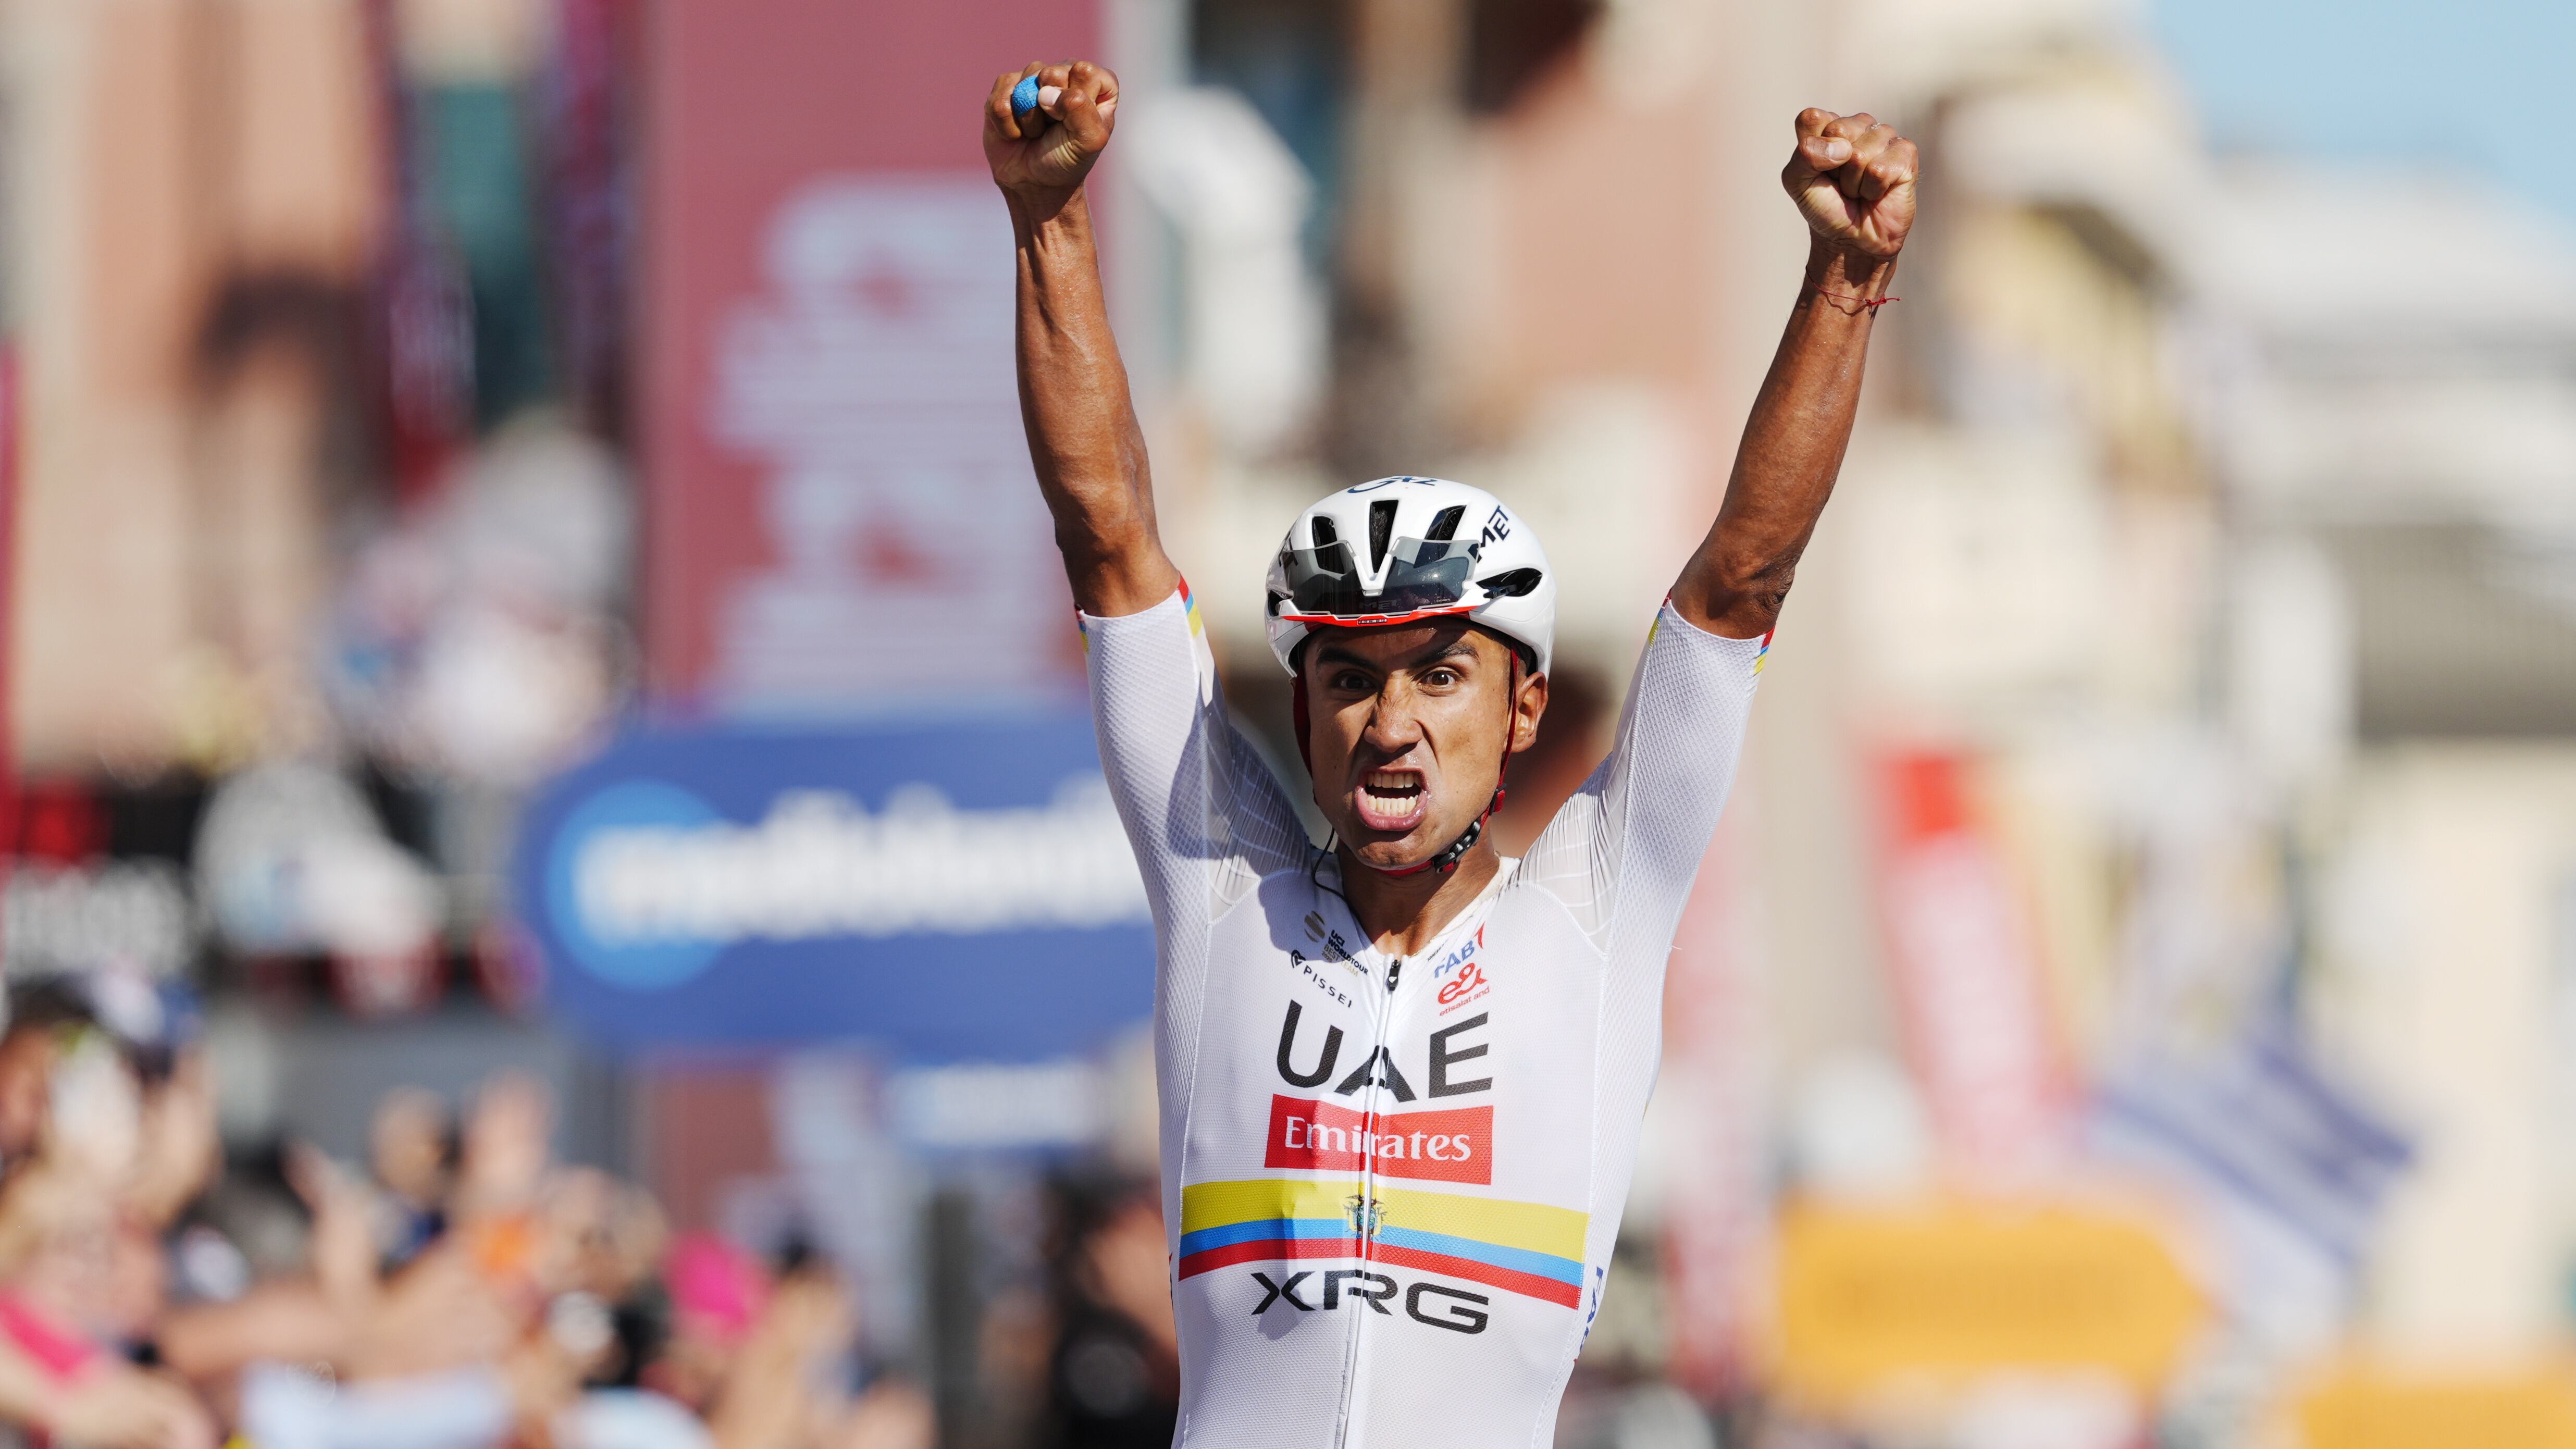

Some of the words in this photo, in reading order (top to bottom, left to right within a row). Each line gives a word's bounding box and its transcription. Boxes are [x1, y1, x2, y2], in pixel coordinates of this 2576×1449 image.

[1468, 505, 1510, 563] MET
[1324, 944, 1341, 961] BEST
[1342, 959, 1359, 976] TEAM
[1328, 936, 1368, 976] WORLDTOUR
[1331, 930, 1345, 947] UCI
[1304, 964, 1352, 1008] PISSEI
[1440, 996, 1471, 1016] etisalat
[1473, 986, 1490, 1000] and
[1277, 999, 1492, 1102] UAE
[1285, 1116, 1471, 1162] Emirates
[1250, 1270, 1490, 1334] XRG
